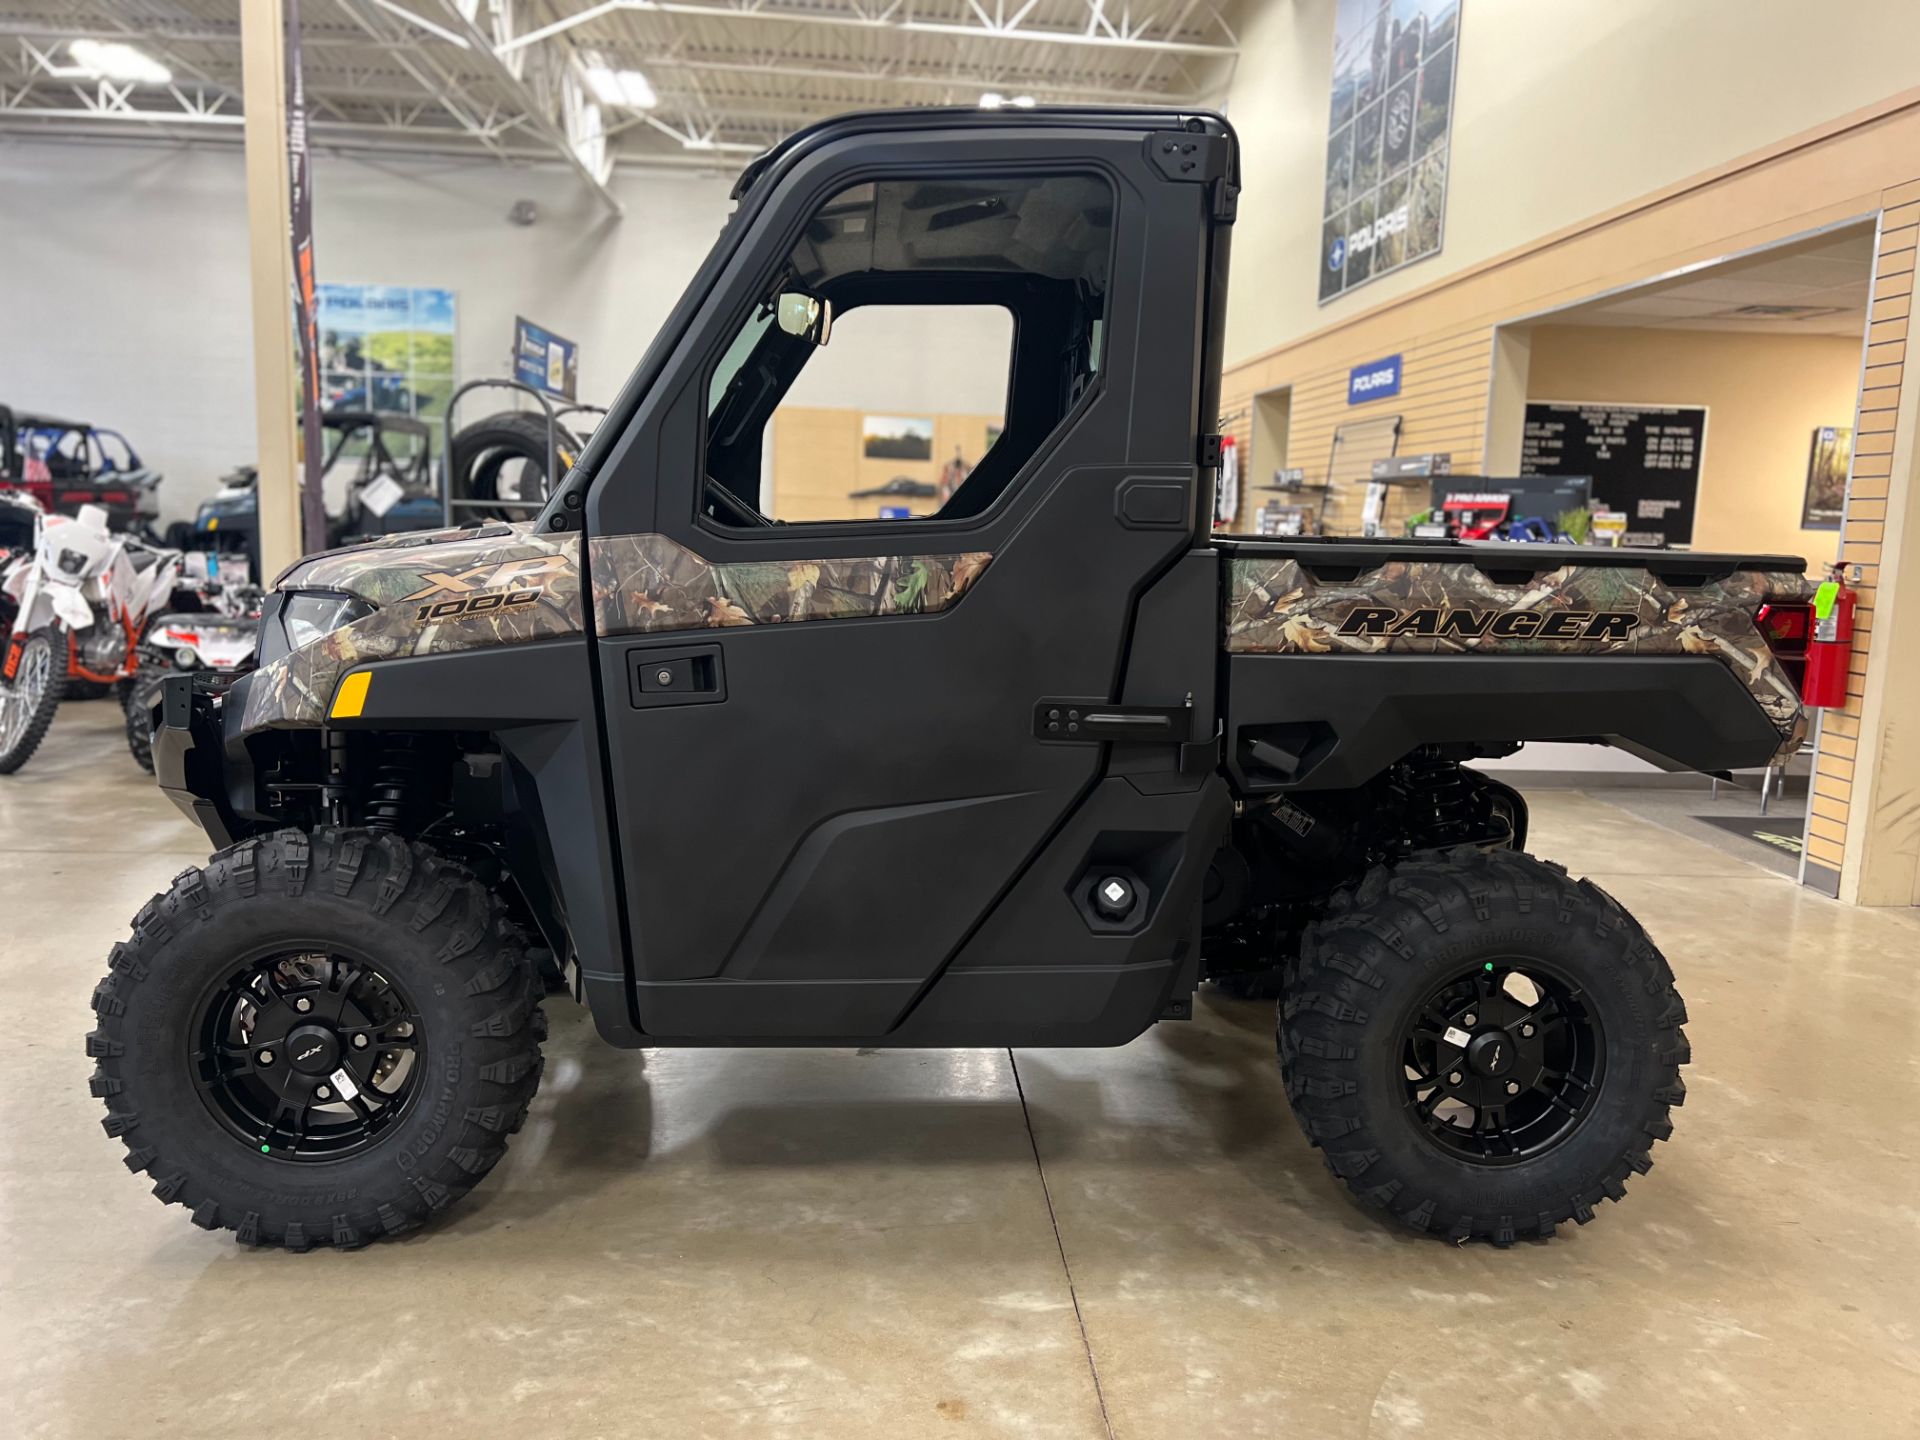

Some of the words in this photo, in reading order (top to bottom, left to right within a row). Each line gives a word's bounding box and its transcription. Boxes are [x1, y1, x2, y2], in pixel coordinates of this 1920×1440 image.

[1348, 205, 1409, 257] POLARIS
[1352, 368, 1394, 392] POLARIS
[394, 554, 571, 602] XP
[415, 586, 544, 621] 1000
[1334, 606, 1641, 640] RANGER
[446, 1040, 462, 1083] PRO
[412, 1086, 455, 1155] ARMOR
